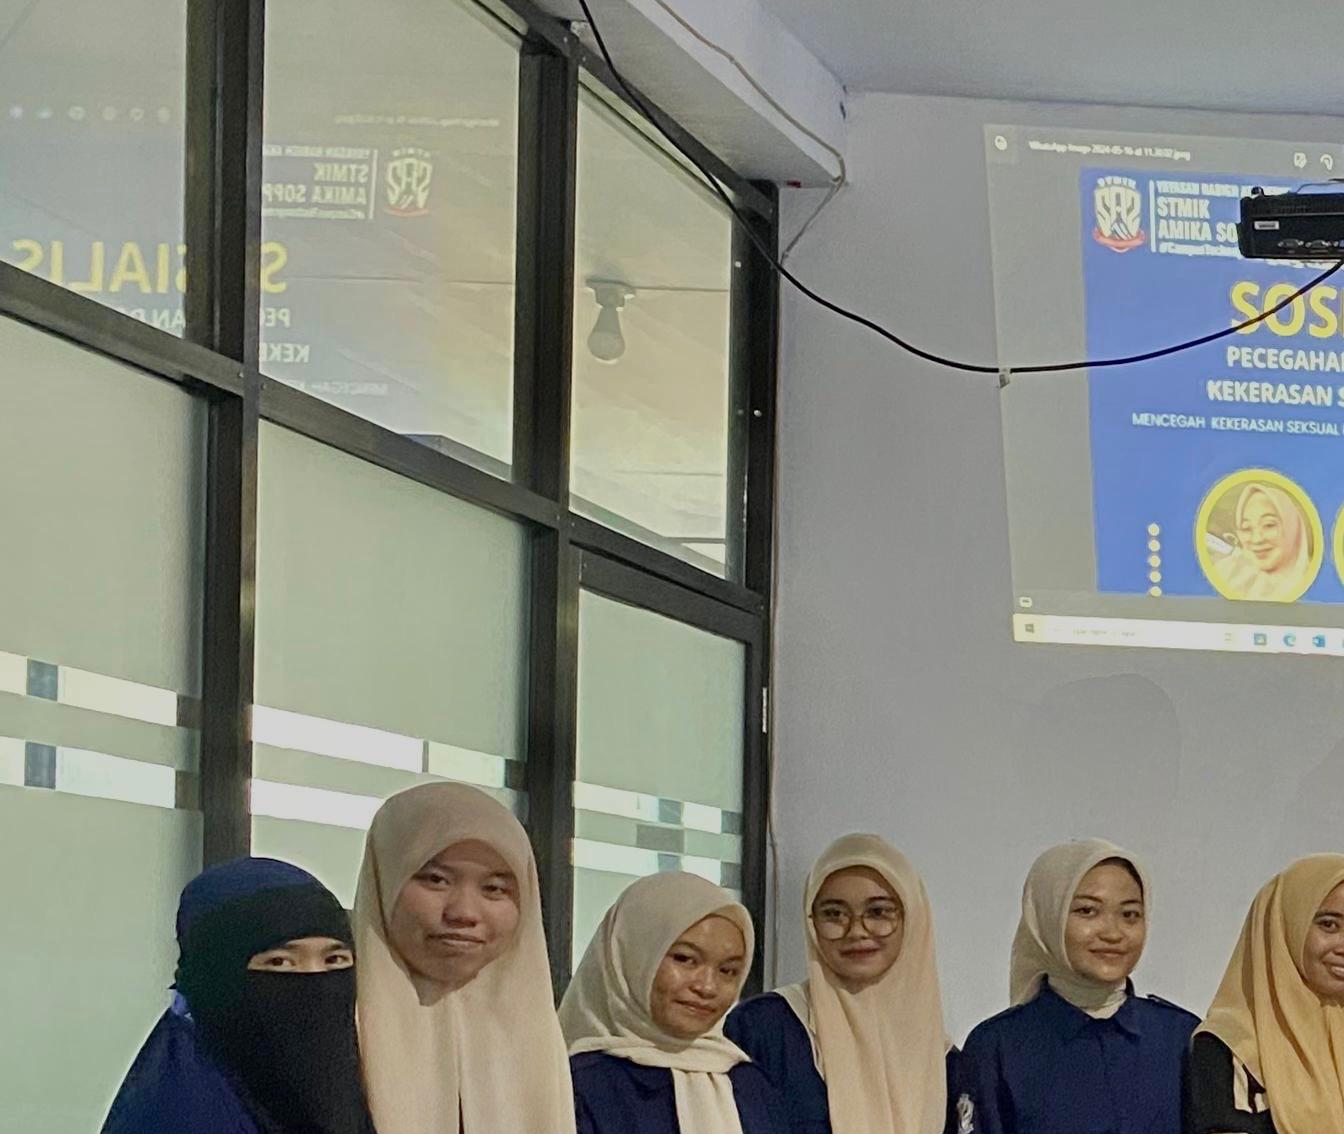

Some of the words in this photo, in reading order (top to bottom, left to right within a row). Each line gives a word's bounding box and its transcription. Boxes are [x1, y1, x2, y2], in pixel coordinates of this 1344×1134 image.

[1157, 196, 1211, 219] STMIK
[1158, 219, 1212, 241] AMIKA
[1207, 379, 1333, 408] KEKERASAN
[1132, 412, 1206, 429] MENCEGAH
[1211, 415, 1284, 433] KEKERASAN
[1286, 419, 1339, 436] SEKSUAL
